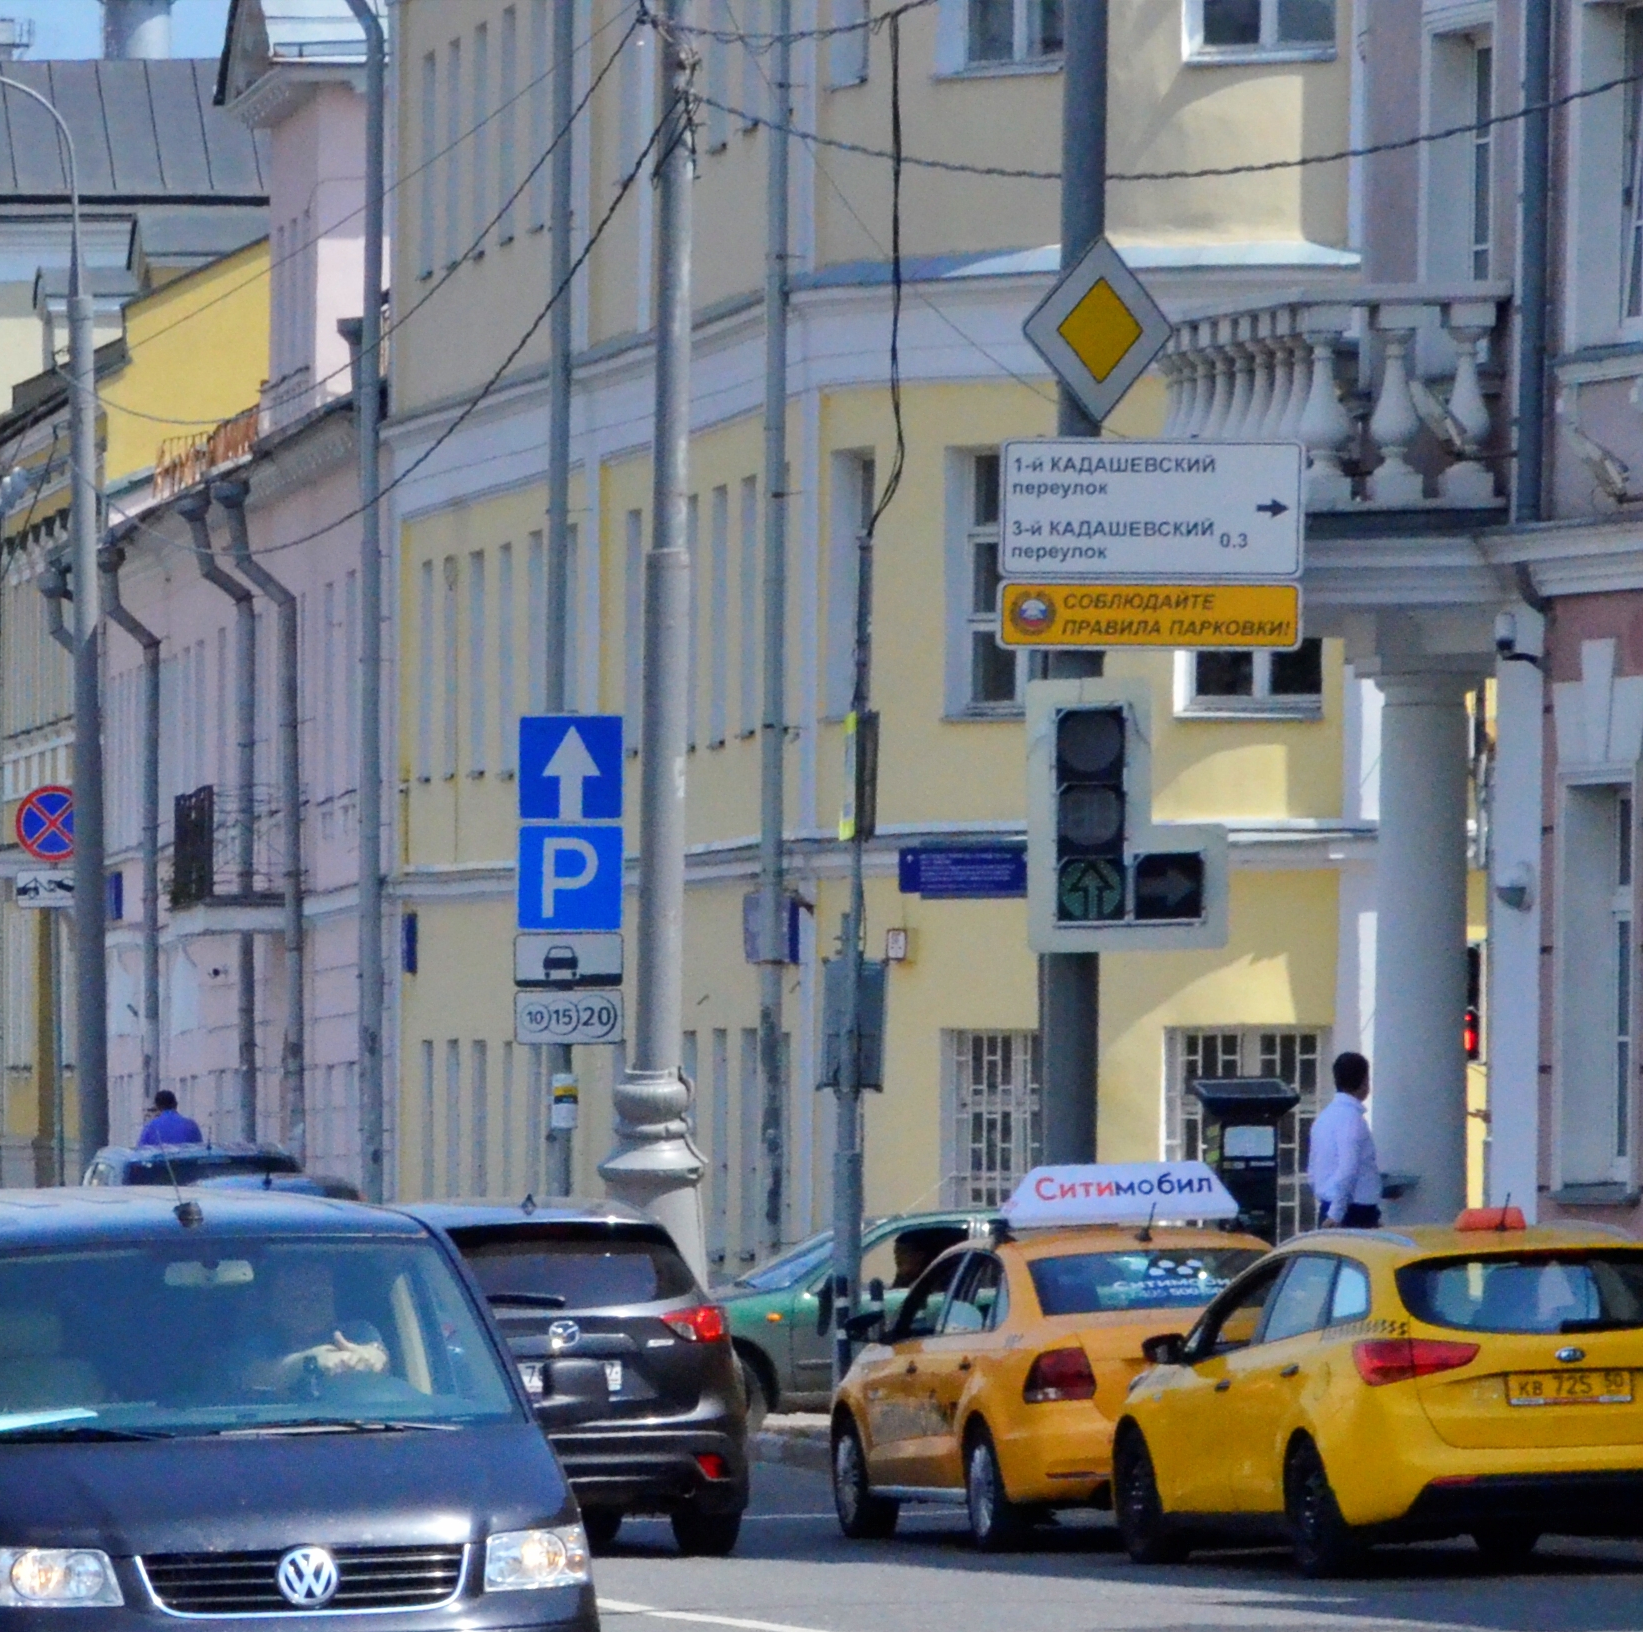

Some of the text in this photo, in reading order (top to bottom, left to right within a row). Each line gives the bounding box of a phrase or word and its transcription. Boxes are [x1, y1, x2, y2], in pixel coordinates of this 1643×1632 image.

[1013, 455, 1216, 473] 1-й КАДАШЕВСКИЙ
[1012, 482, 1108, 499] переулок
[1012, 518, 1214, 537] 3-й КАДАШЕВСКИЙ
[1219, 533, 1248, 549] 0.3
[1011, 546, 1107, 563] переулок
[1064, 592, 1215, 611] СОБЛЮДАЙТЕ
[1062, 619, 1291, 637] ПРАВИЛА ПАРКОВКИ!
[526, 1006, 612, 1027] 10 15 20
[1034, 1171, 1213, 1201] Ситимобил
